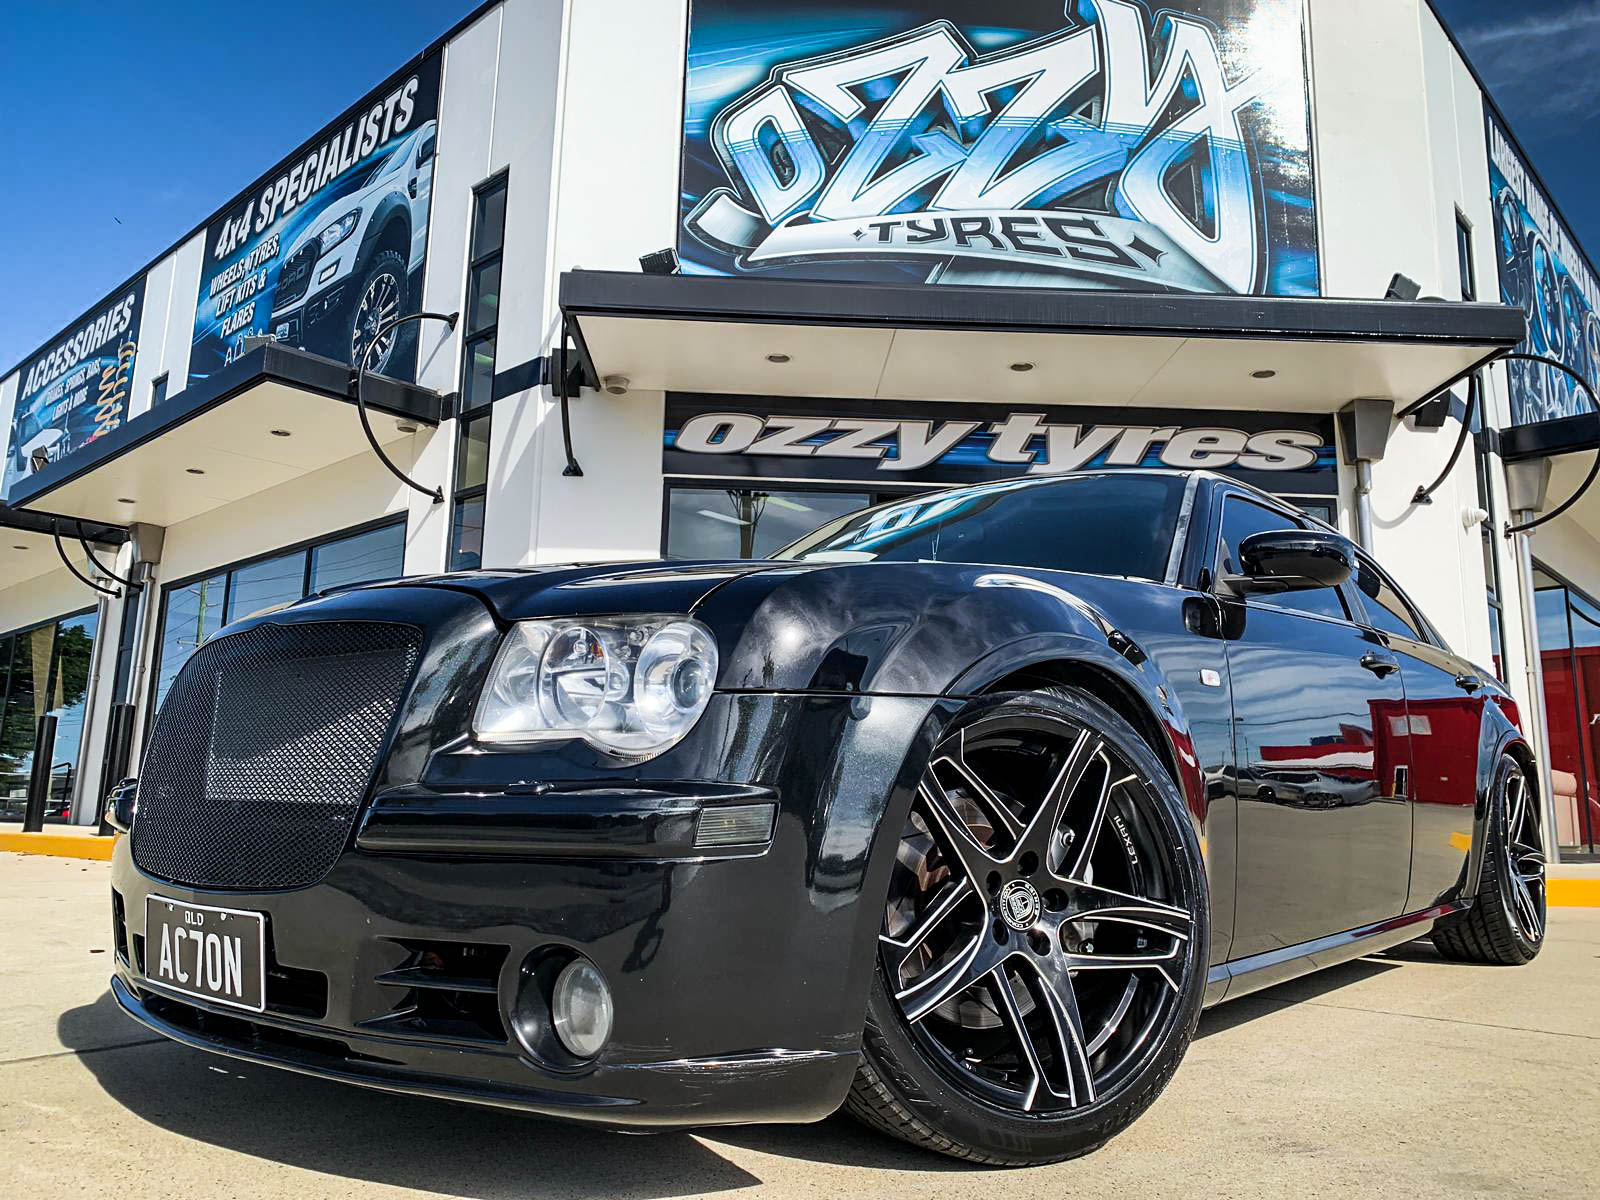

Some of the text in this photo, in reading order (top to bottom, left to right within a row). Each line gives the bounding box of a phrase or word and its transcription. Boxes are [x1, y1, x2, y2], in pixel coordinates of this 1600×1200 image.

[256, 75, 419, 233] SPECIALISTS
[210, 232, 280, 298] WHEELS, TYRES,
[861, 215, 1142, 269] TYRES
[215, 267, 267, 318] LIFT KITS &
[220, 301, 256, 339] FLARES
[21, 291, 135, 401] ACCESSORIES
[675, 411, 1325, 474] ozzy tyres
[185, 911, 204, 926] QLD
